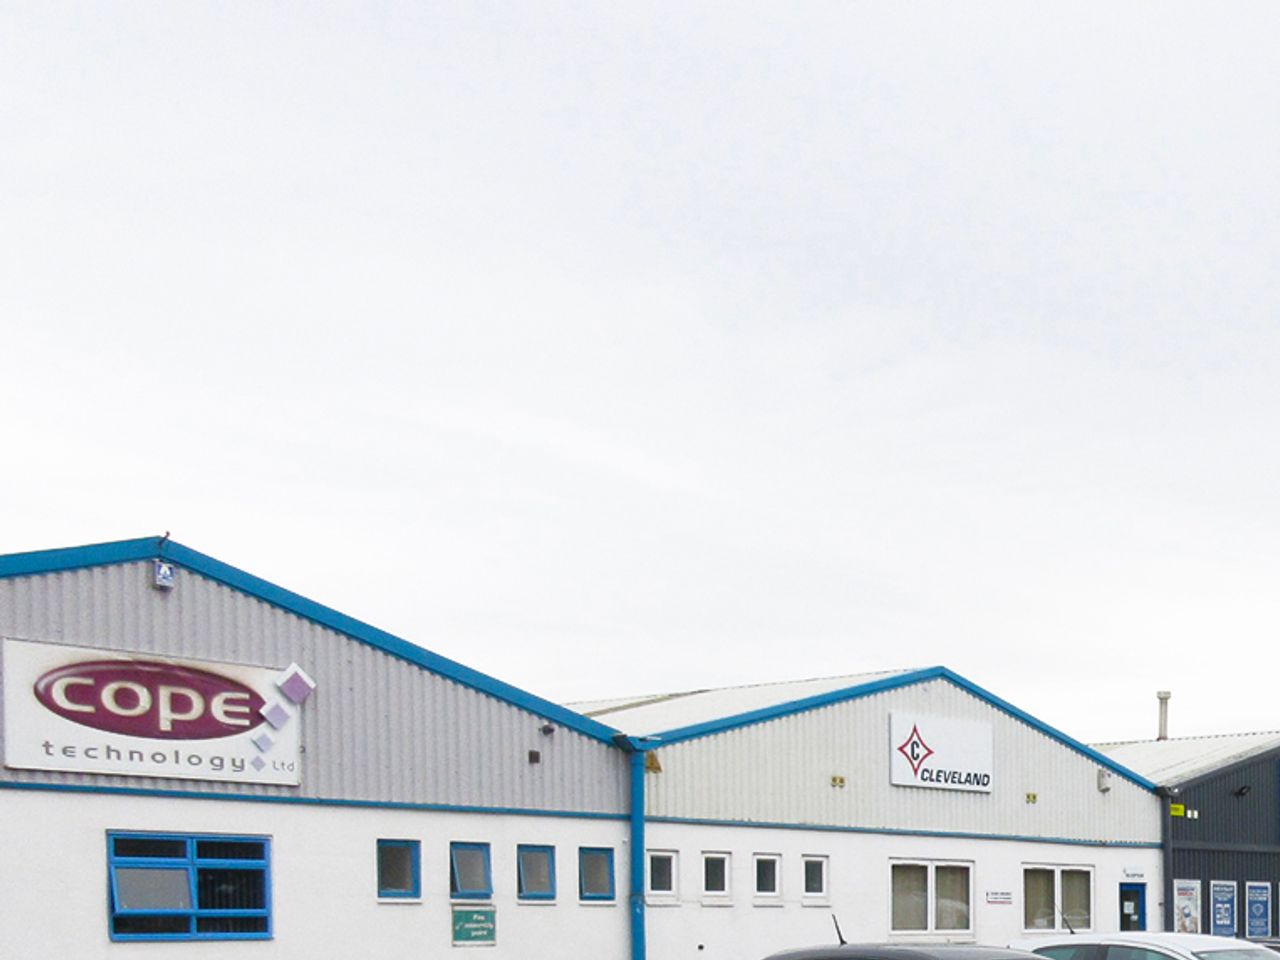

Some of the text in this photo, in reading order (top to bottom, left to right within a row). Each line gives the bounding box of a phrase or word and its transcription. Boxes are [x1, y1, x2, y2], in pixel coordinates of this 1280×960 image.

[42, 740, 295, 772] technology Ltd
[911, 740, 920, 761] C
[920, 768, 990, 787] CLEVELAND
